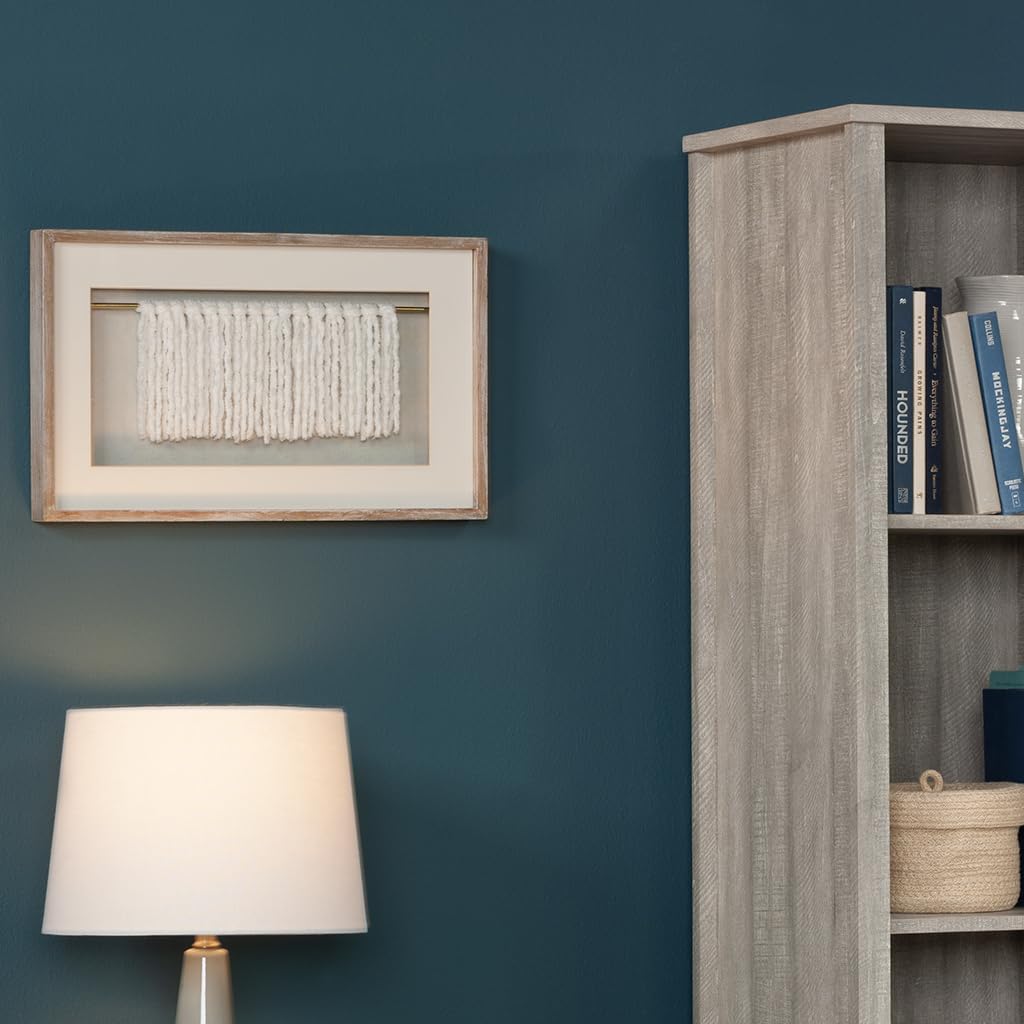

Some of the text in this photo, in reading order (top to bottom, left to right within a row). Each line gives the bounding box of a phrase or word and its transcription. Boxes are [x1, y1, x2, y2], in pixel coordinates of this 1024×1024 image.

[984, 320, 995, 346] COLLINS
[896, 390, 908, 464] HOUNDED
[929, 379, 938, 419] Everything
[992, 371, 1012, 449] MOCKINGJAY
